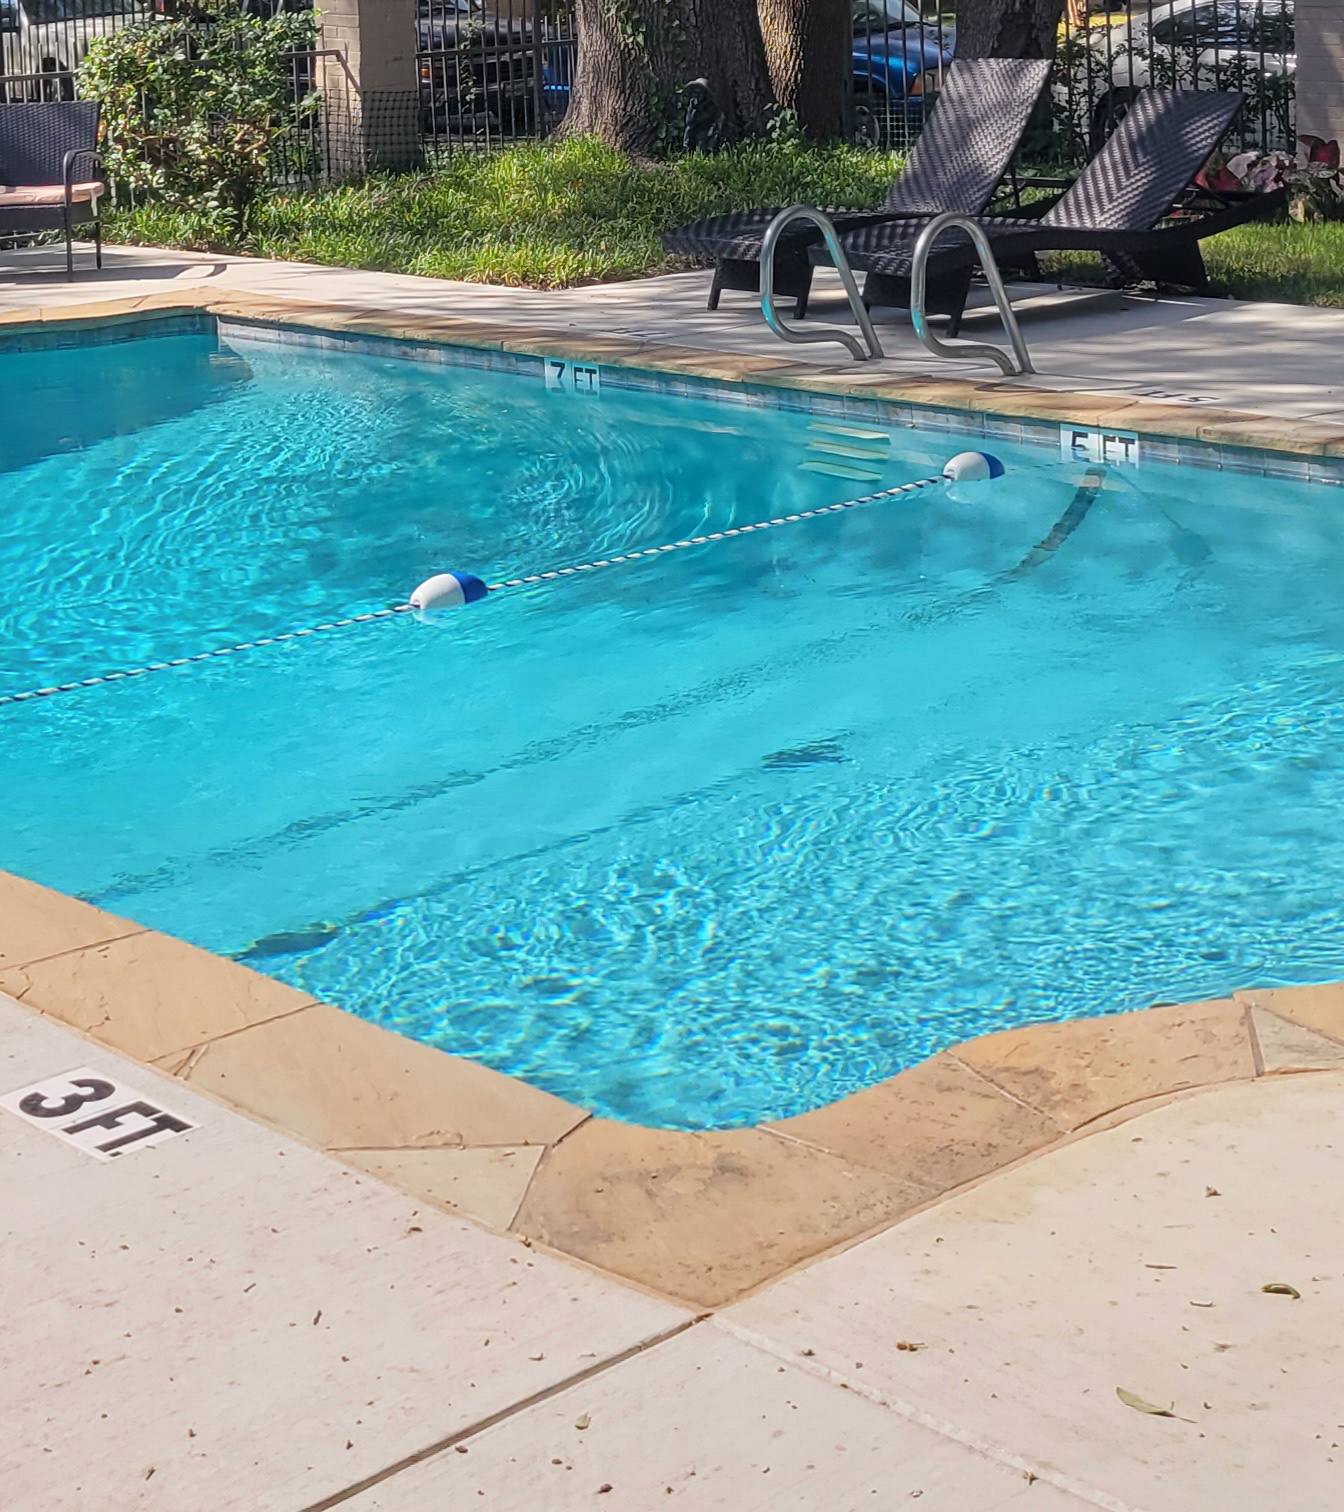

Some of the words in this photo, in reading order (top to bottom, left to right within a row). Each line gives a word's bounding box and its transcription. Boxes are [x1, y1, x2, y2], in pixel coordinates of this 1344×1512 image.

[550, 361, 565, 379] 7
[574, 366, 596, 385] FT
[1103, 435, 1136, 458] FT
